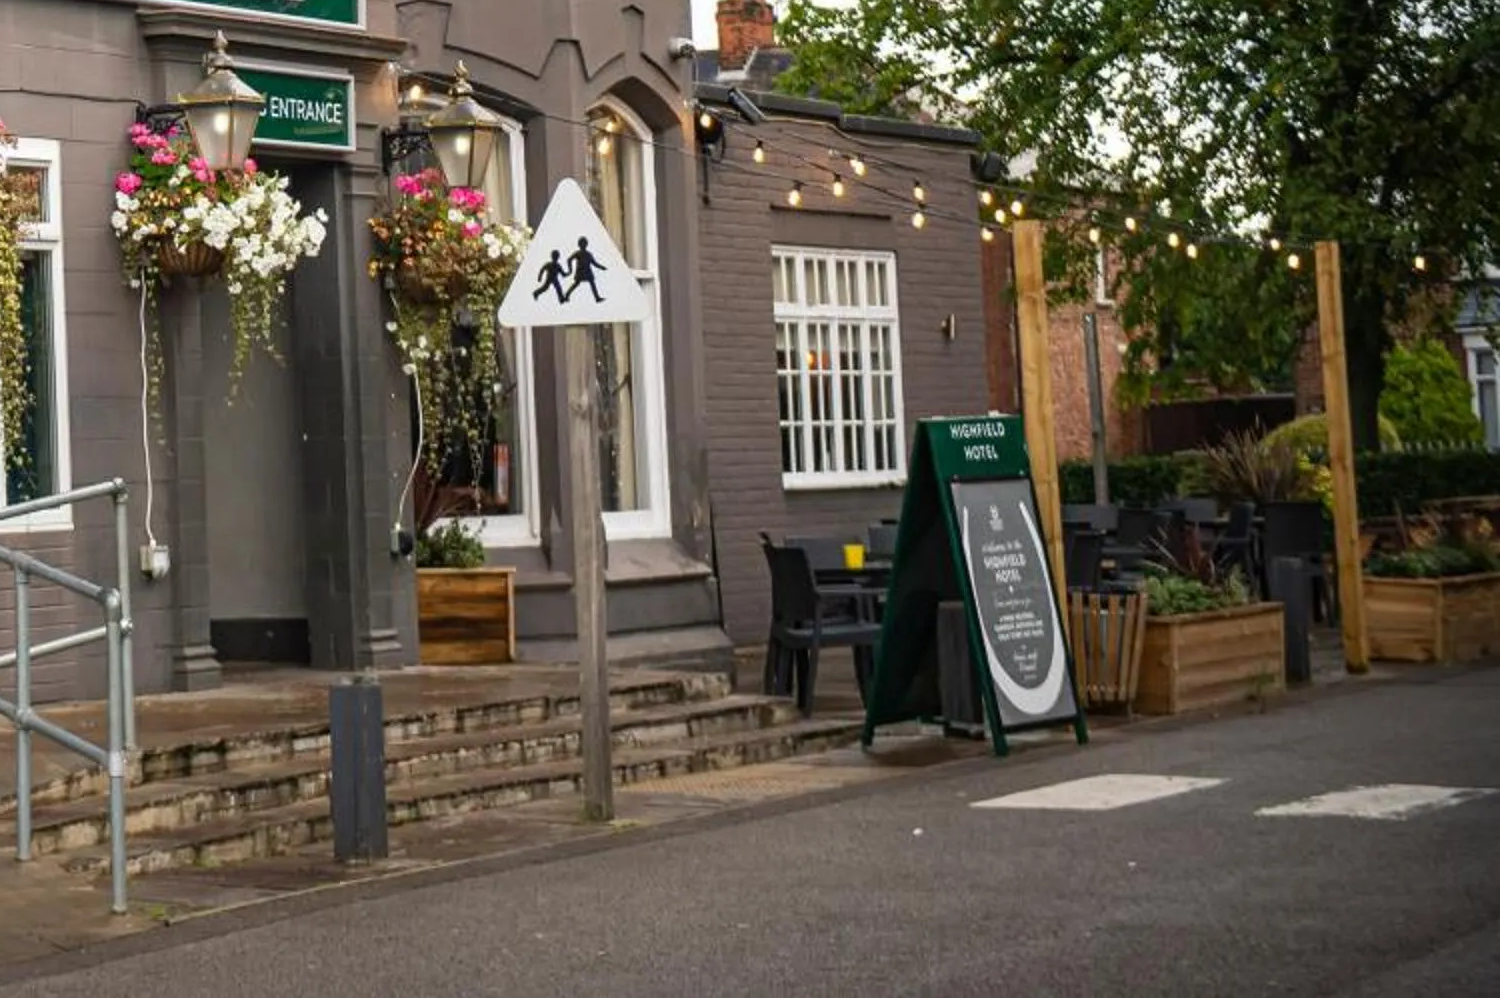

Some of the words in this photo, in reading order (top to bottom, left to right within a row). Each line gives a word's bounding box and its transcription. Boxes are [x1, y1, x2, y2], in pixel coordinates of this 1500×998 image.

[270, 96, 342, 123] ENTRANCE
[950, 422, 1005, 438] HIGHFIELD
[964, 444, 999, 460] HOTEL
